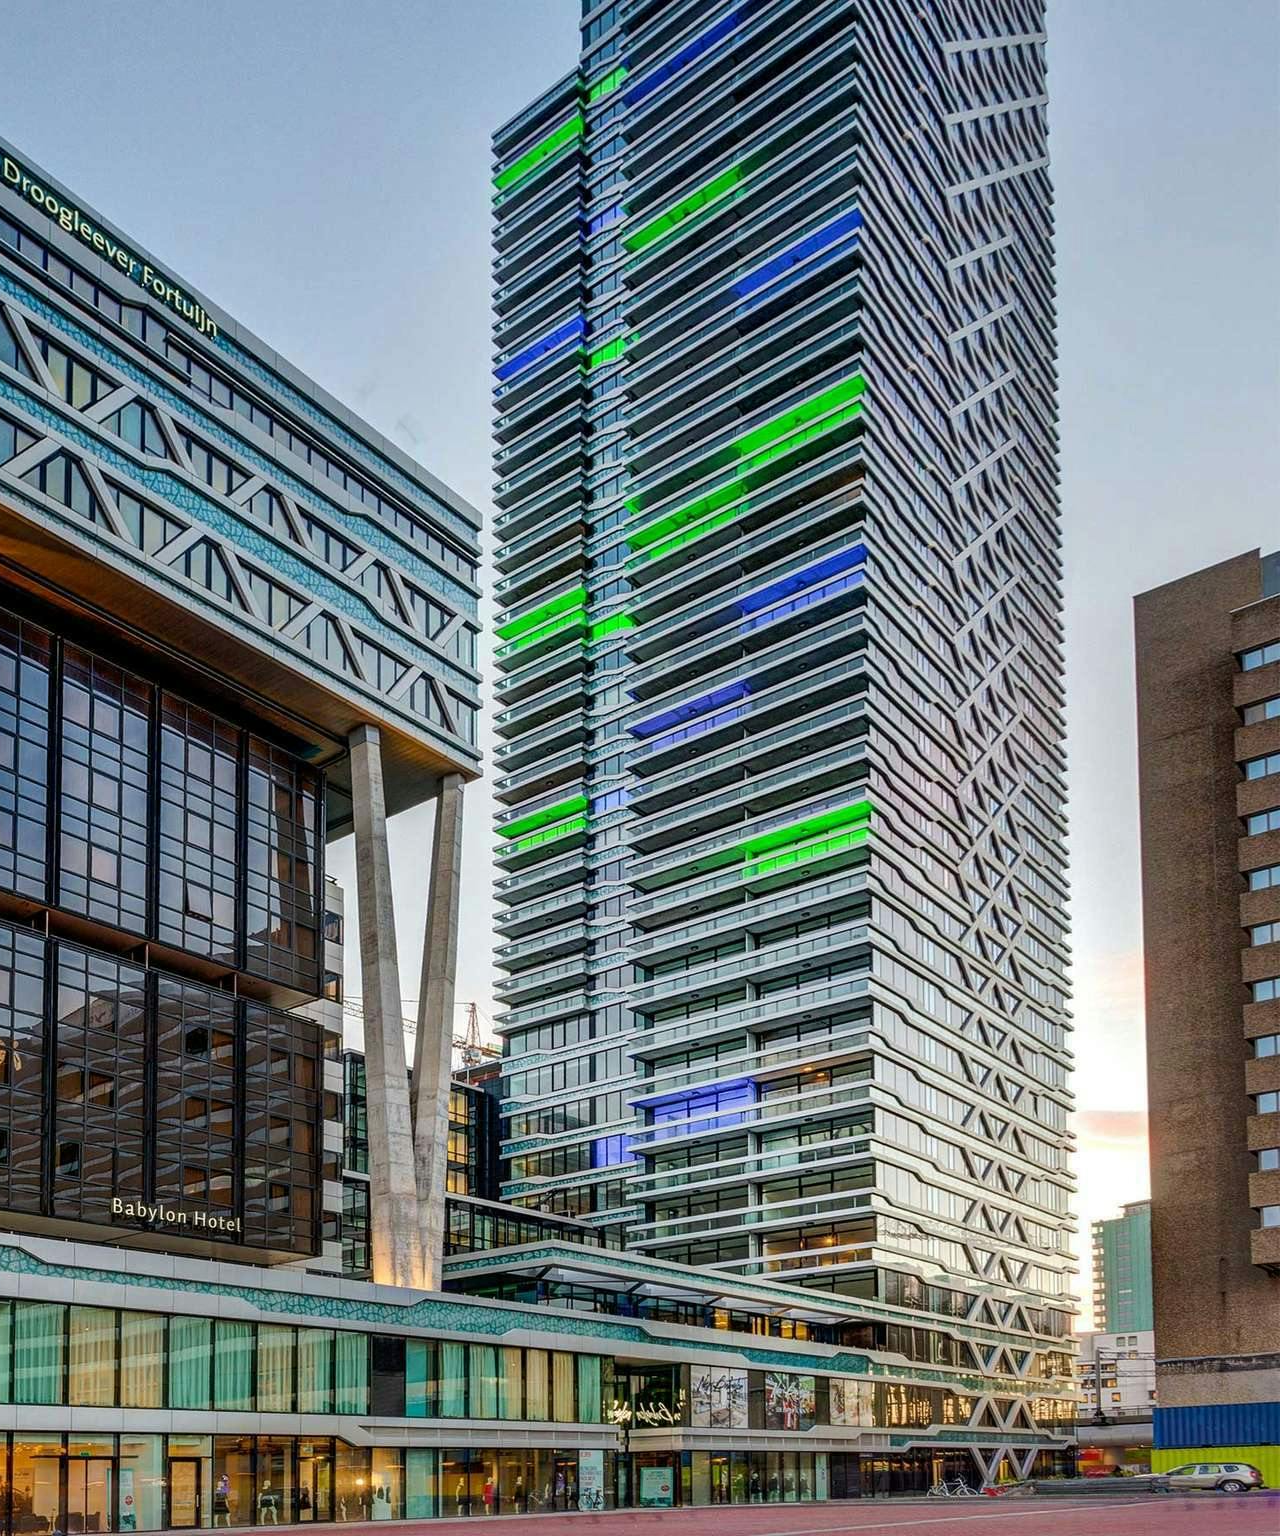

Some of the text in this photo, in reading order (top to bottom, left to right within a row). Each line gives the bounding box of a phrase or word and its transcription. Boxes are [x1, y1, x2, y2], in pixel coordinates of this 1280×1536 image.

[3, 157, 137, 274] Droogleever
[143, 265, 218, 337] Fortuijn
[113, 1198, 241, 1232] Babylon Hotel
